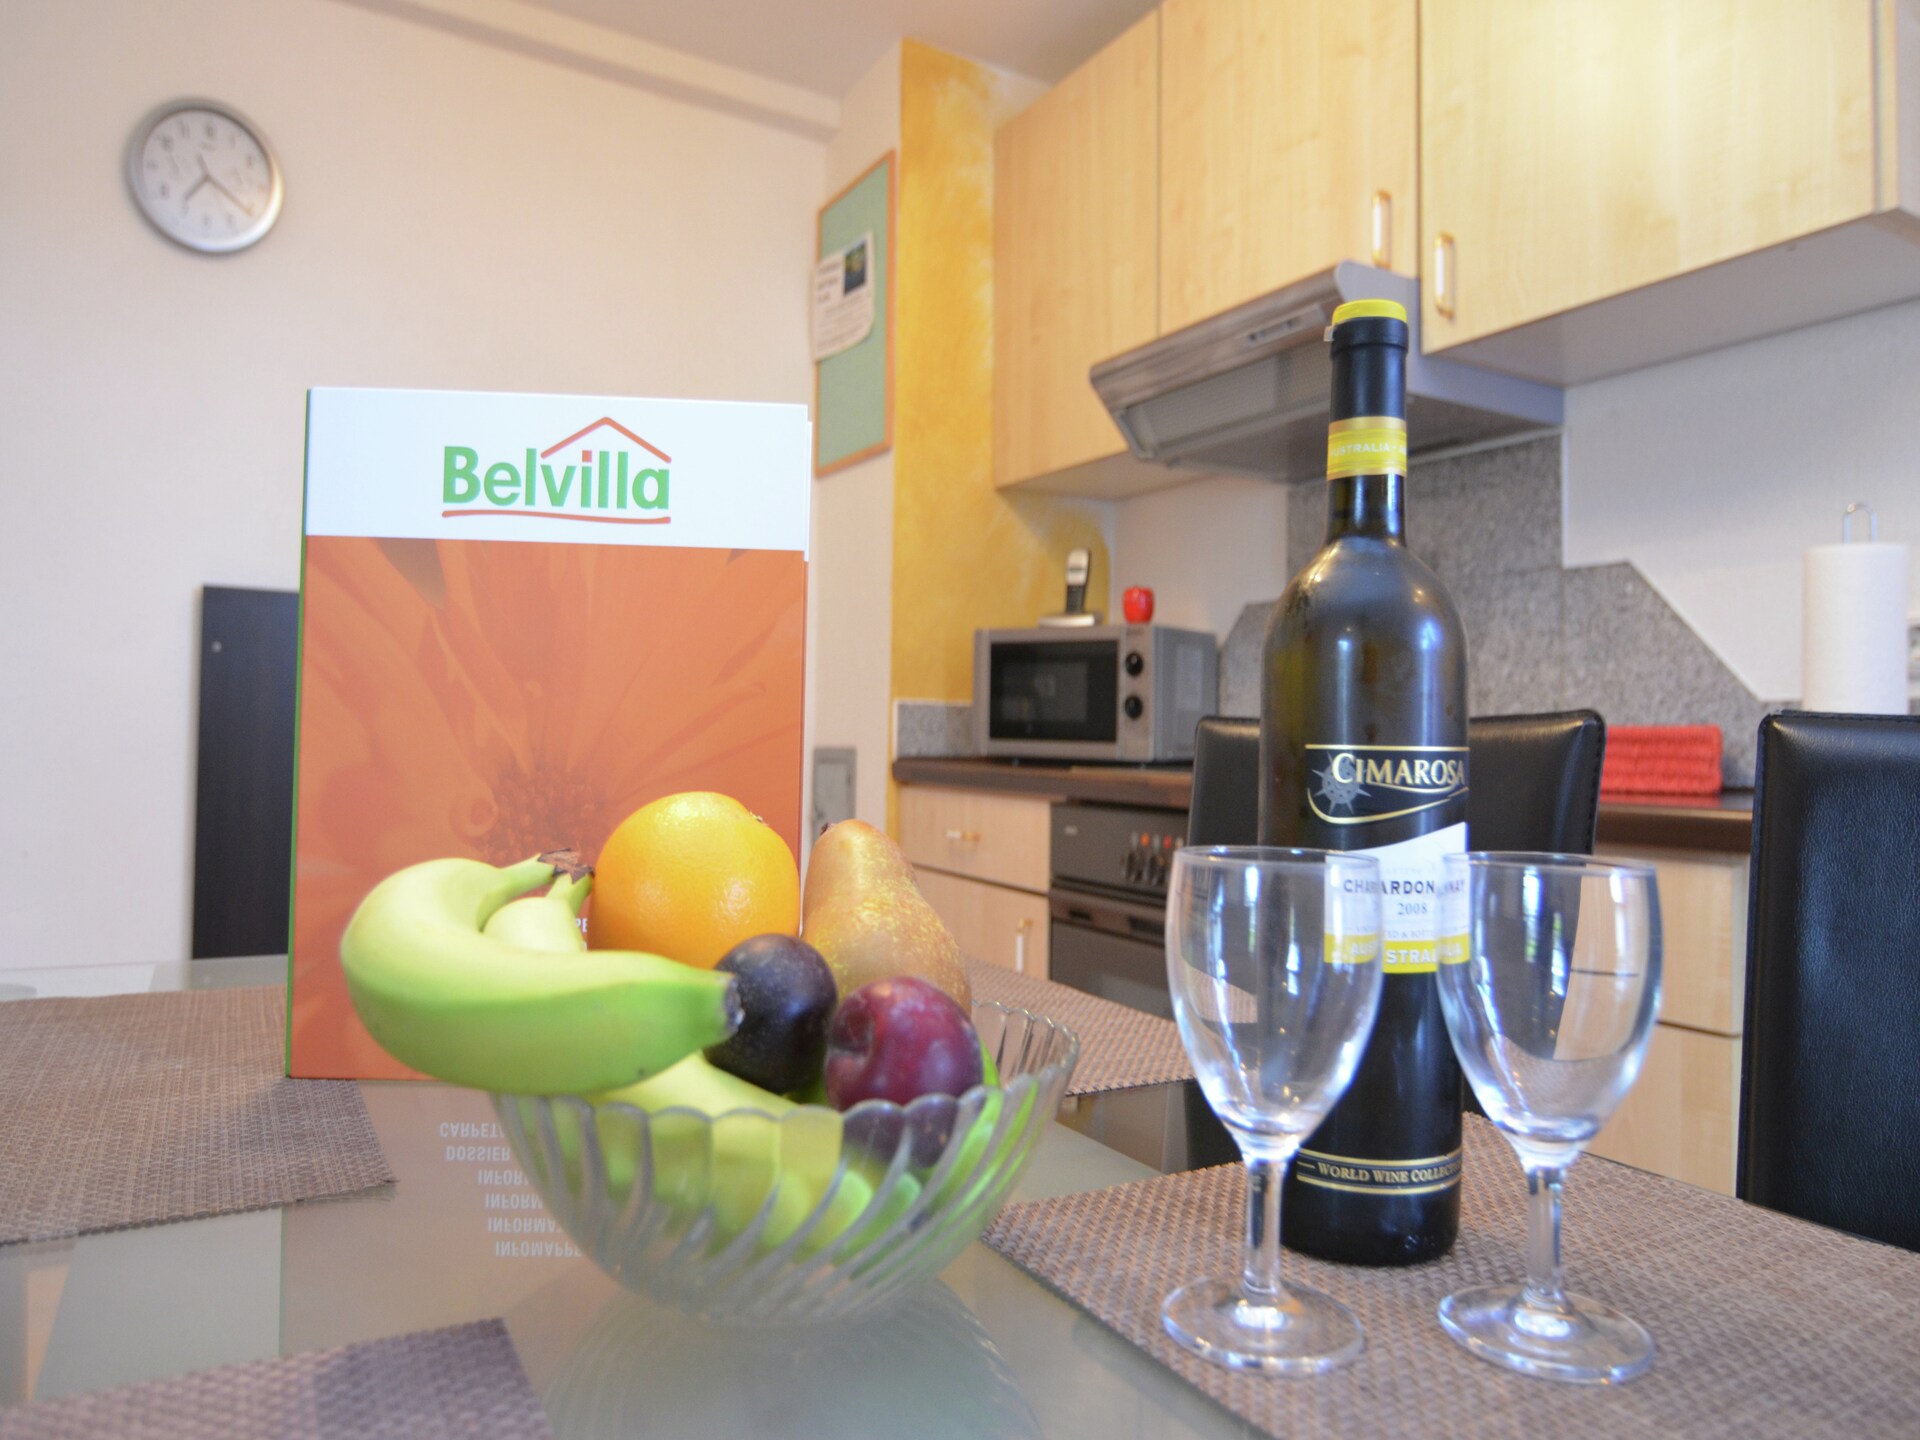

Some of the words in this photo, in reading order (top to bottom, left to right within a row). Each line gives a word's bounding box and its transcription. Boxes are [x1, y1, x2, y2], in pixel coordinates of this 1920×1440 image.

[443, 446, 670, 510] Belvilla
[1331, 752, 1466, 785] CIMAROSA
[1397, 902, 1428, 915] 2008
[1317, 1161, 1370, 1182] WORLD
[1372, 1169, 1409, 1184] WINE
[1411, 1158, 1460, 1182] COLLEC
